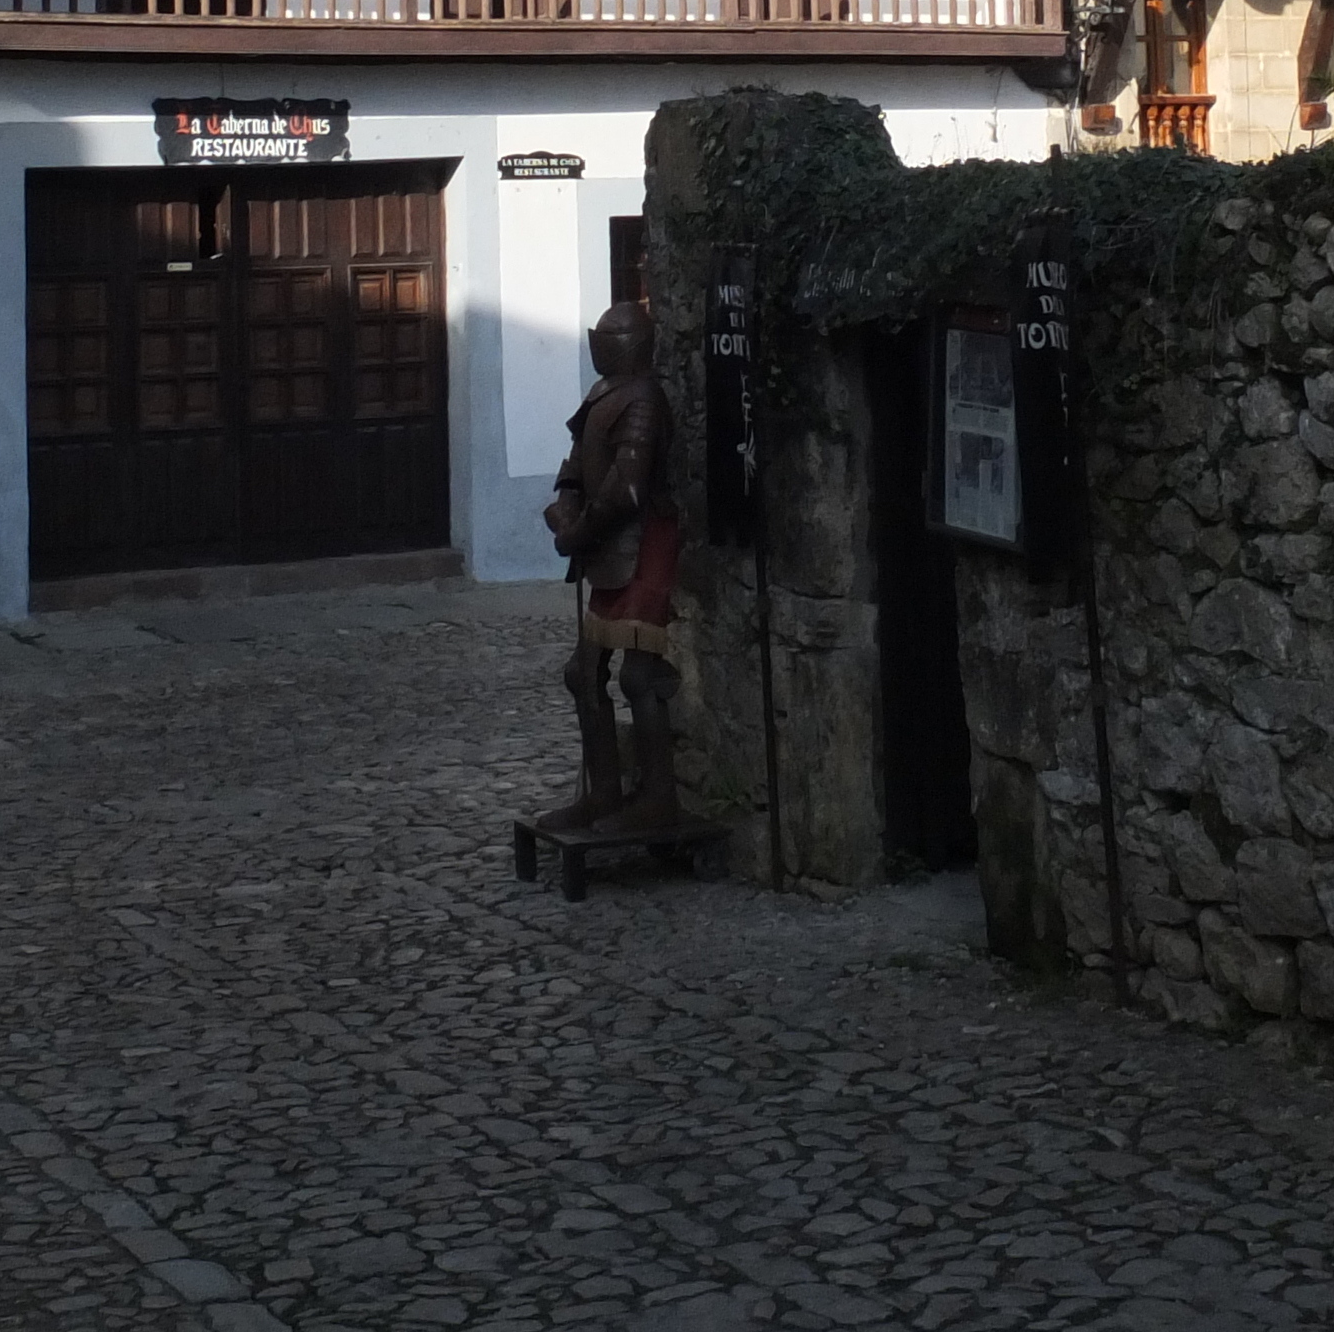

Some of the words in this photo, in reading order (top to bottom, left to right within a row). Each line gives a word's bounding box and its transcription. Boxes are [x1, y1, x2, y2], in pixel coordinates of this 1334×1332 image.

[176, 112, 201, 134] La
[207, 109, 269, 135] Taberna
[271, 109, 287, 135] de
[289, 110, 331, 142] Chus
[190, 137, 309, 158] RESTAURANTE
